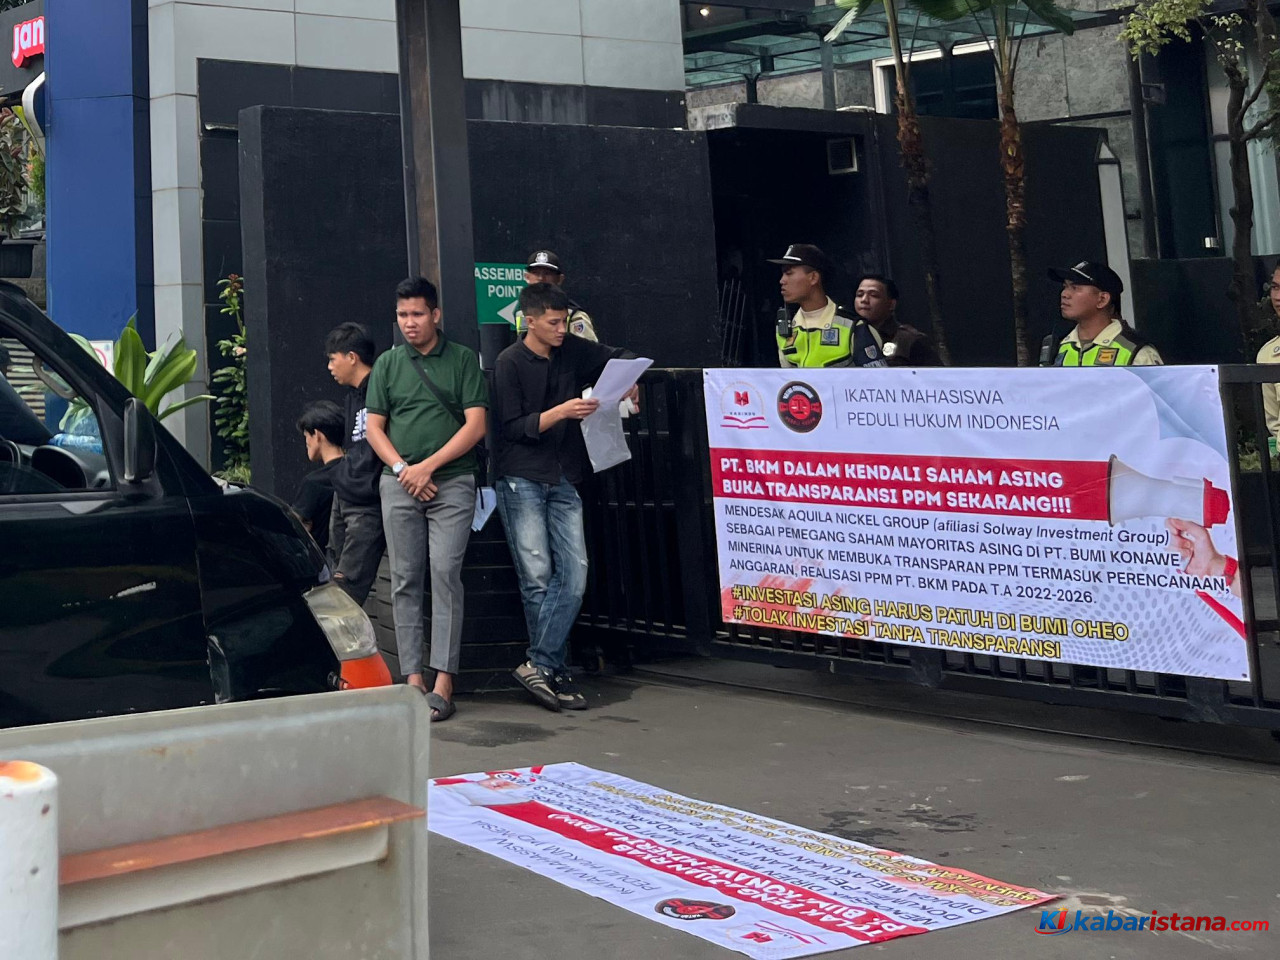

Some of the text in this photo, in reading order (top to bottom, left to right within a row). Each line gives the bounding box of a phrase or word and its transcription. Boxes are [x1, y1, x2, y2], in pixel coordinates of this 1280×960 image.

[13, 18, 44, 59] jan
[475, 267, 527, 280] ASSEMB
[488, 285, 523, 297] POINT
[845, 389, 1003, 404] IKATAN MAHASISWA
[848, 412, 1060, 430] PEDULI HUKUM INDONESIA
[721, 458, 1063, 488] PT. BKM DALAM KENDALI SAHAM ASING
[723, 480, 1071, 513] BUKA TRANSPARANSI PPM SEKARANG!!!
[725, 505, 1169, 546] MENDESAK AQUILA NICKEL GROUP (afiliasi Solway Investment Group)
[726, 523, 1180, 566] SEBAGAI PEMEGANG SAHAM MAYORITAS ASING DI PT. BUMI KONAWE
[728, 541, 1230, 594] MINERINA UNTUK MEMBUKA TRANSPARAN PPM TERMASUK PERENCANAAN,
[730, 559, 1097, 604] ANGGARAN, REALISASI PPM PT. BKM PADA T.A 2022-2026.
[732, 584, 1129, 641] #INVESTASI ASING HARUS PATUH DI BUMI OHEO
[733, 606, 1061, 658] #TOLAK INVESTASI TANPA TRANSPARANSI
